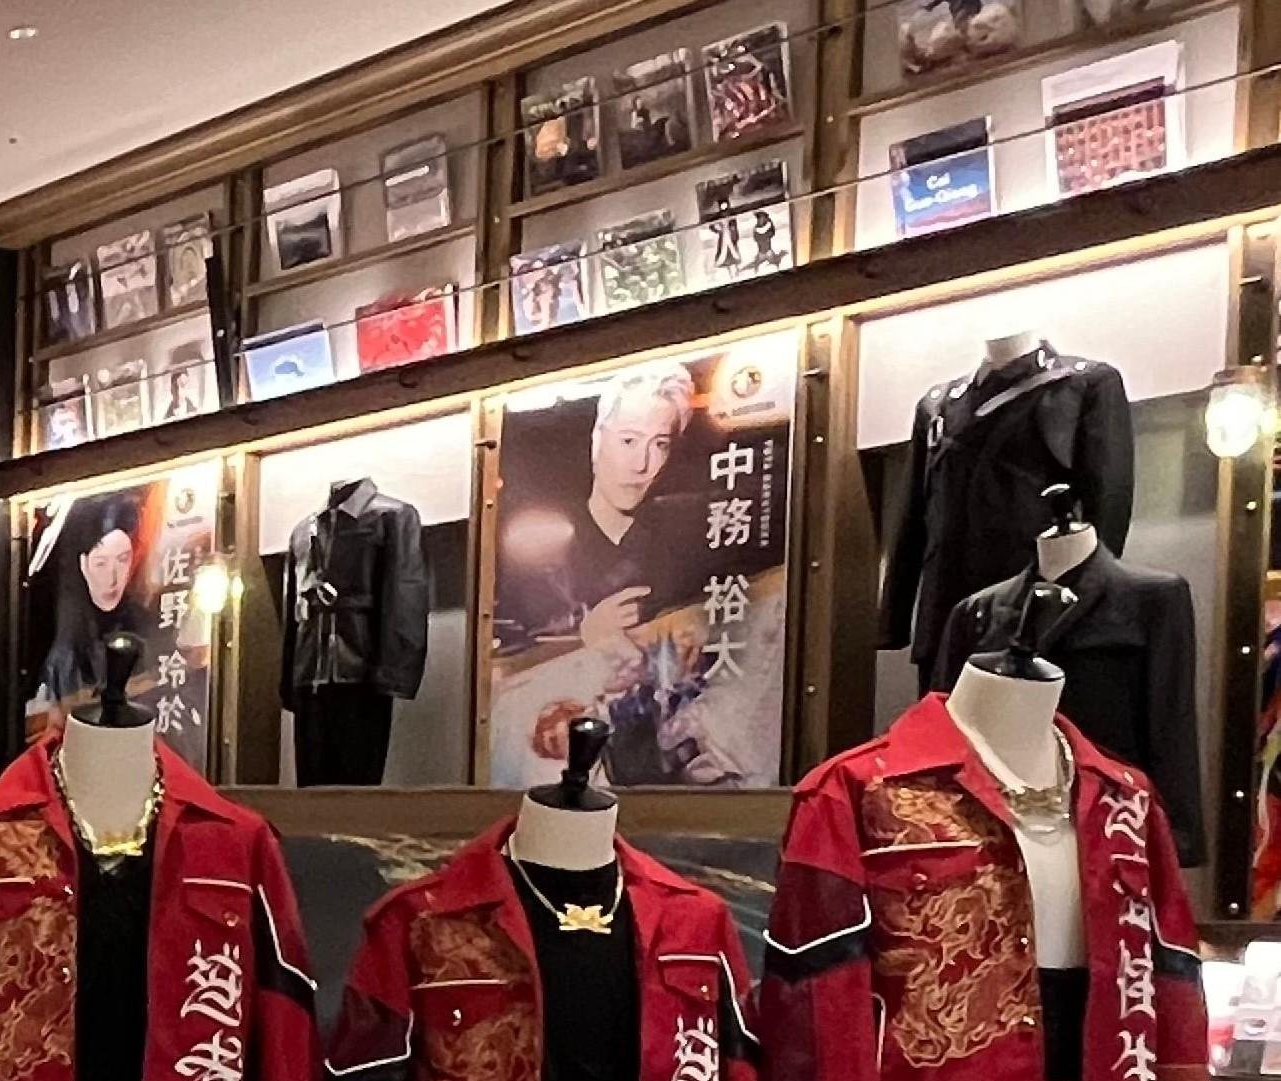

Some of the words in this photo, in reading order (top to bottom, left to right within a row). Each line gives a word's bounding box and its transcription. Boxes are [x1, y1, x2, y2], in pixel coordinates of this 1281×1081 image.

[706, 442, 754, 549] 中務
[159, 548, 191, 629] 佐野
[701, 574, 750, 679] 裕太
[156, 650, 187, 732] 玲於
